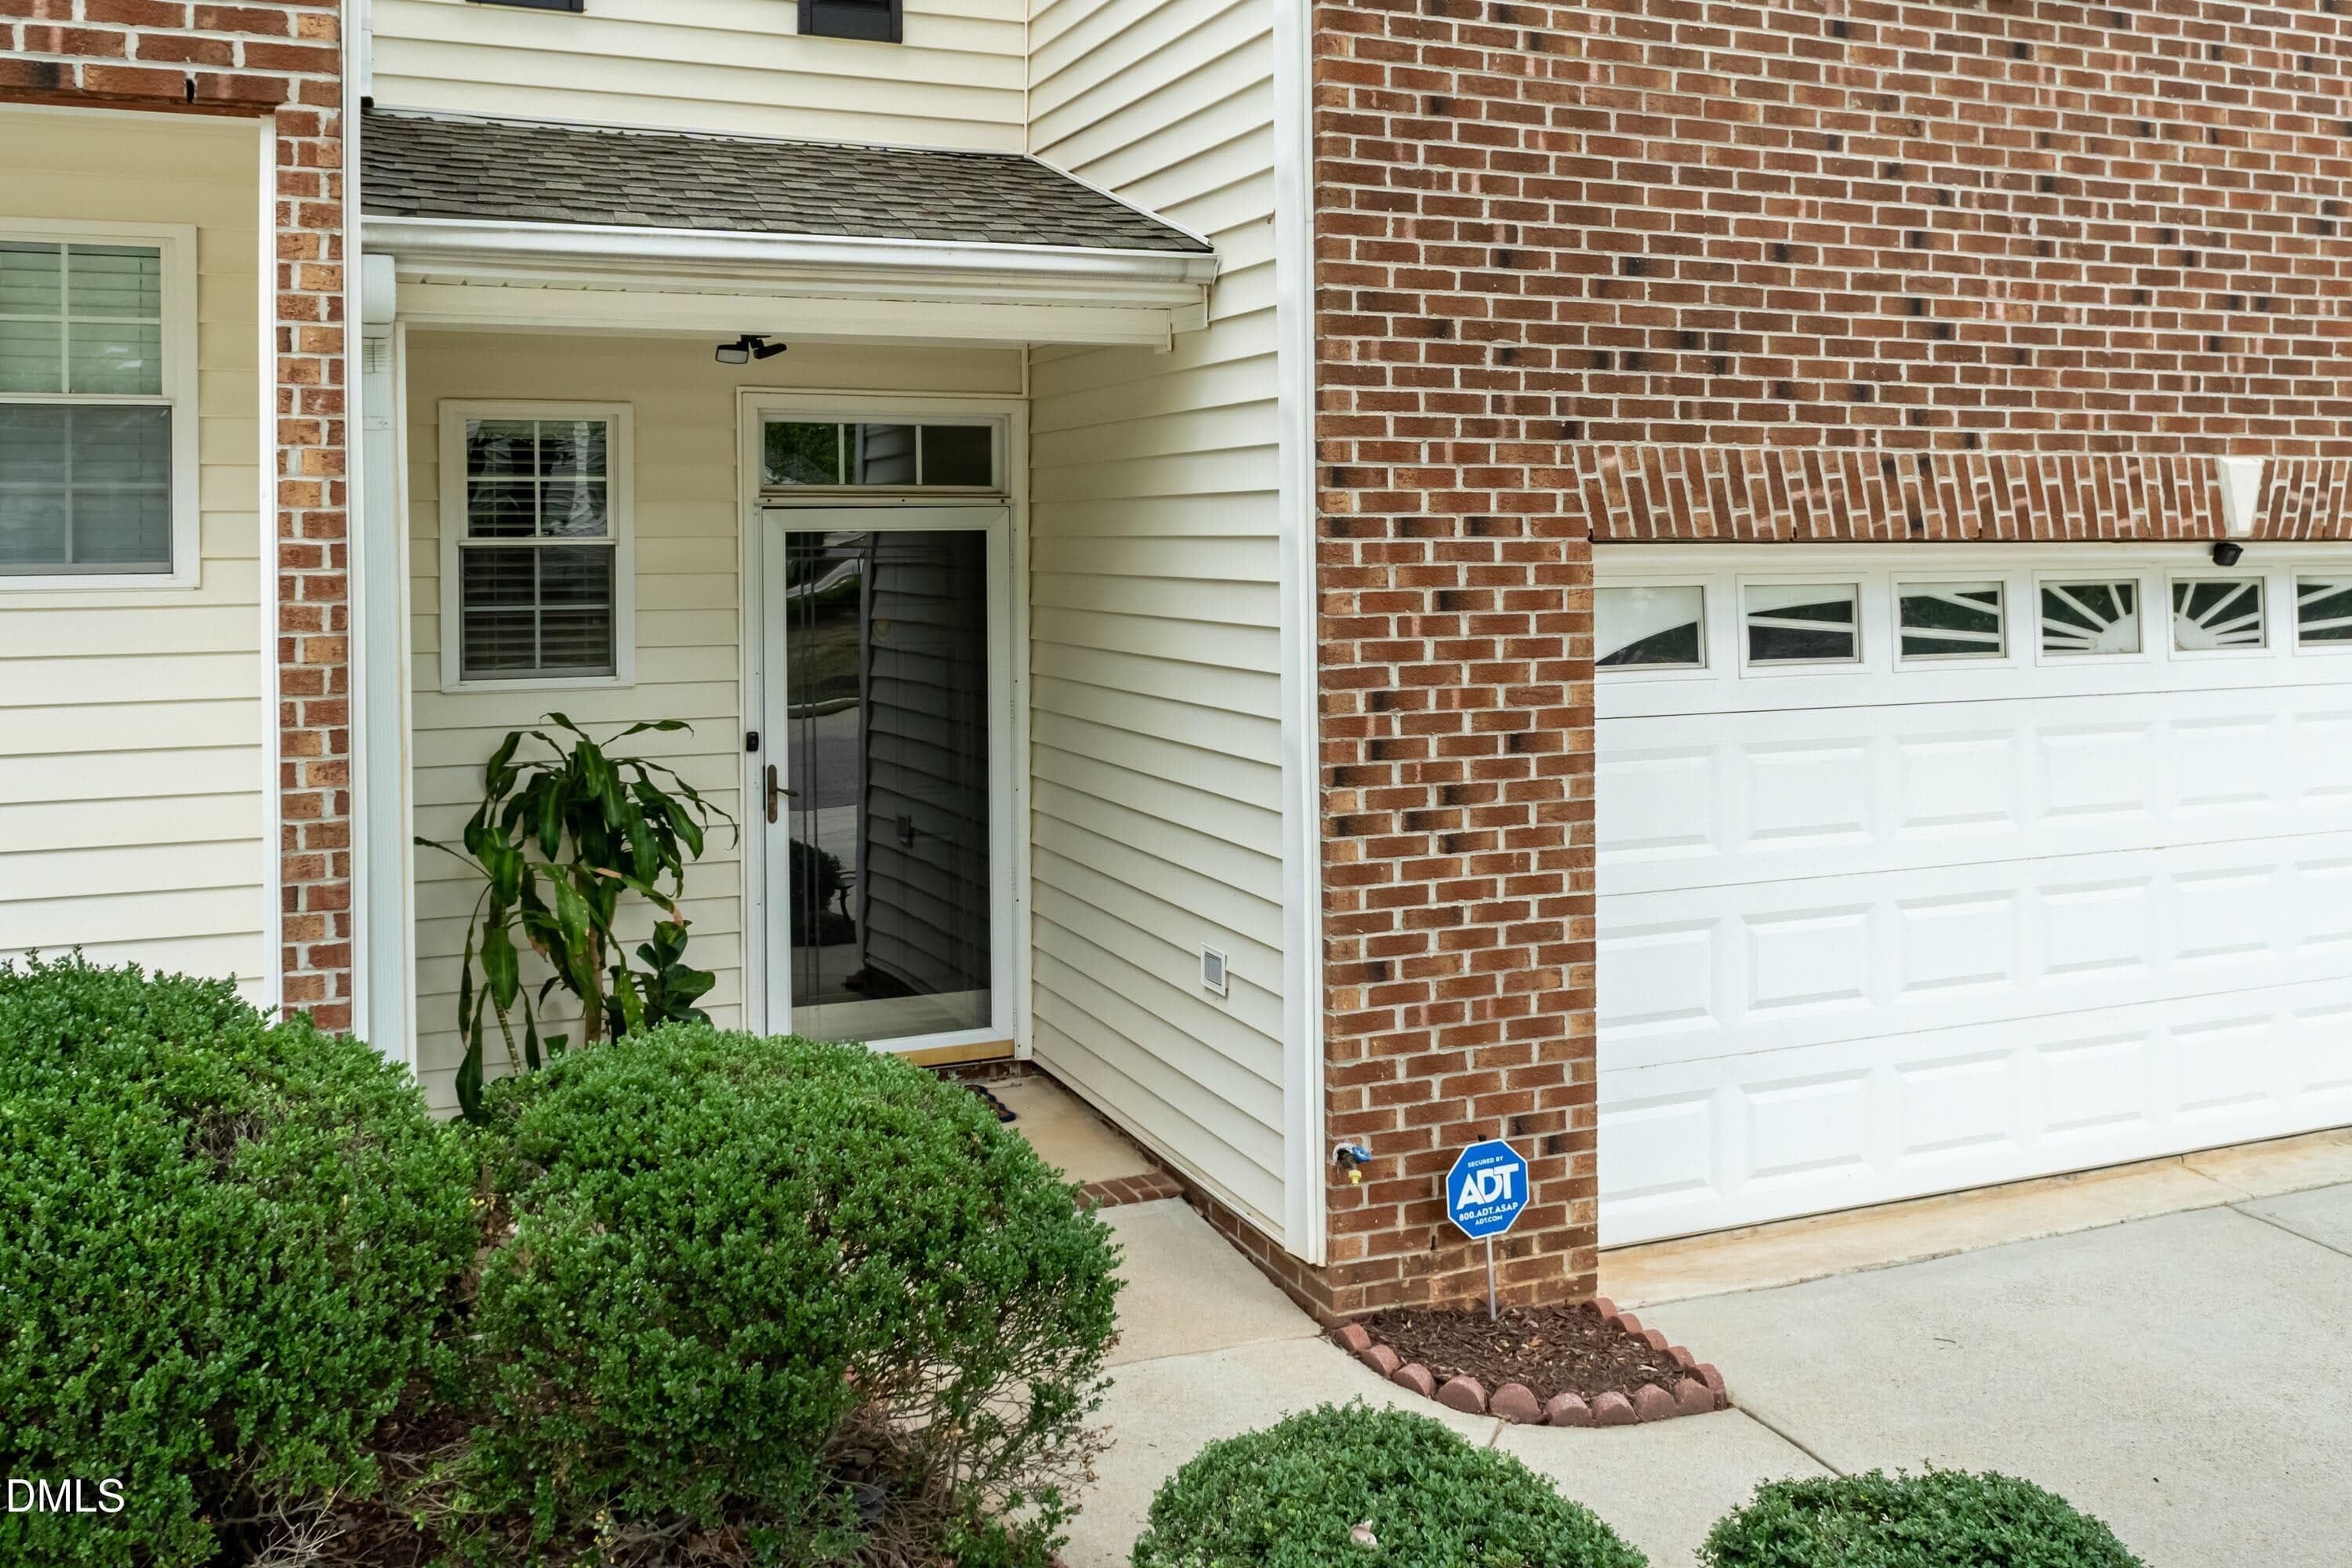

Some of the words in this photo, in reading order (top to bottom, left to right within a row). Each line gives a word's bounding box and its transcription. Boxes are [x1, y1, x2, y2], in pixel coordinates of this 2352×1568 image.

[1468, 1157, 1494, 1167] SECURED
[1456, 1163, 1519, 1210] ADT
[1459, 1202, 1519, 1221] 800.ADT.ASAP
[1475, 1214, 1503, 1225] ADT.COM
